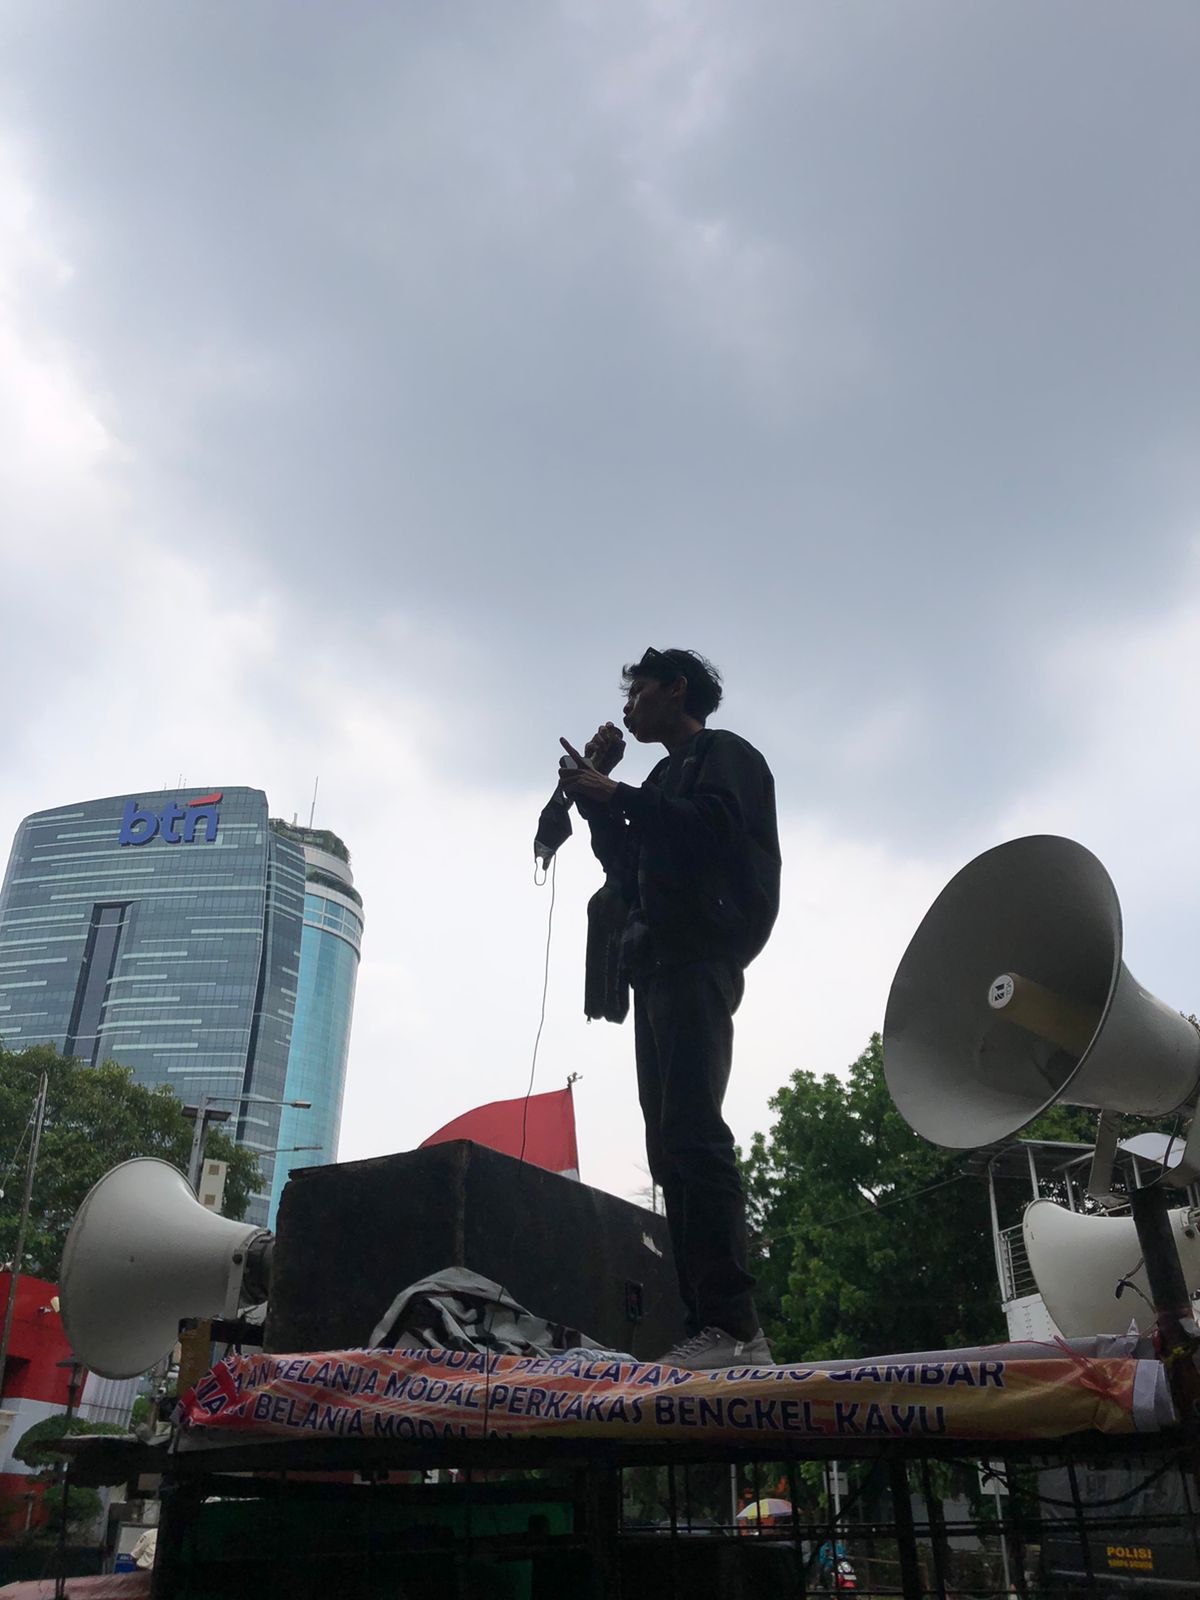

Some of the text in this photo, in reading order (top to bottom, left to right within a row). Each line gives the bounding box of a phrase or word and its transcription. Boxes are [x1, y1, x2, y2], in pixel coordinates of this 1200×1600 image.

[118, 792, 223, 846] btn
[383, 1372, 481, 1408] MODAL
[488, 1383, 645, 1424] PERKAKAS
[655, 1396, 824, 1432] BENGKEL
[834, 1402, 948, 1434] KAYU
[1106, 1546, 1152, 1559] POLISI
